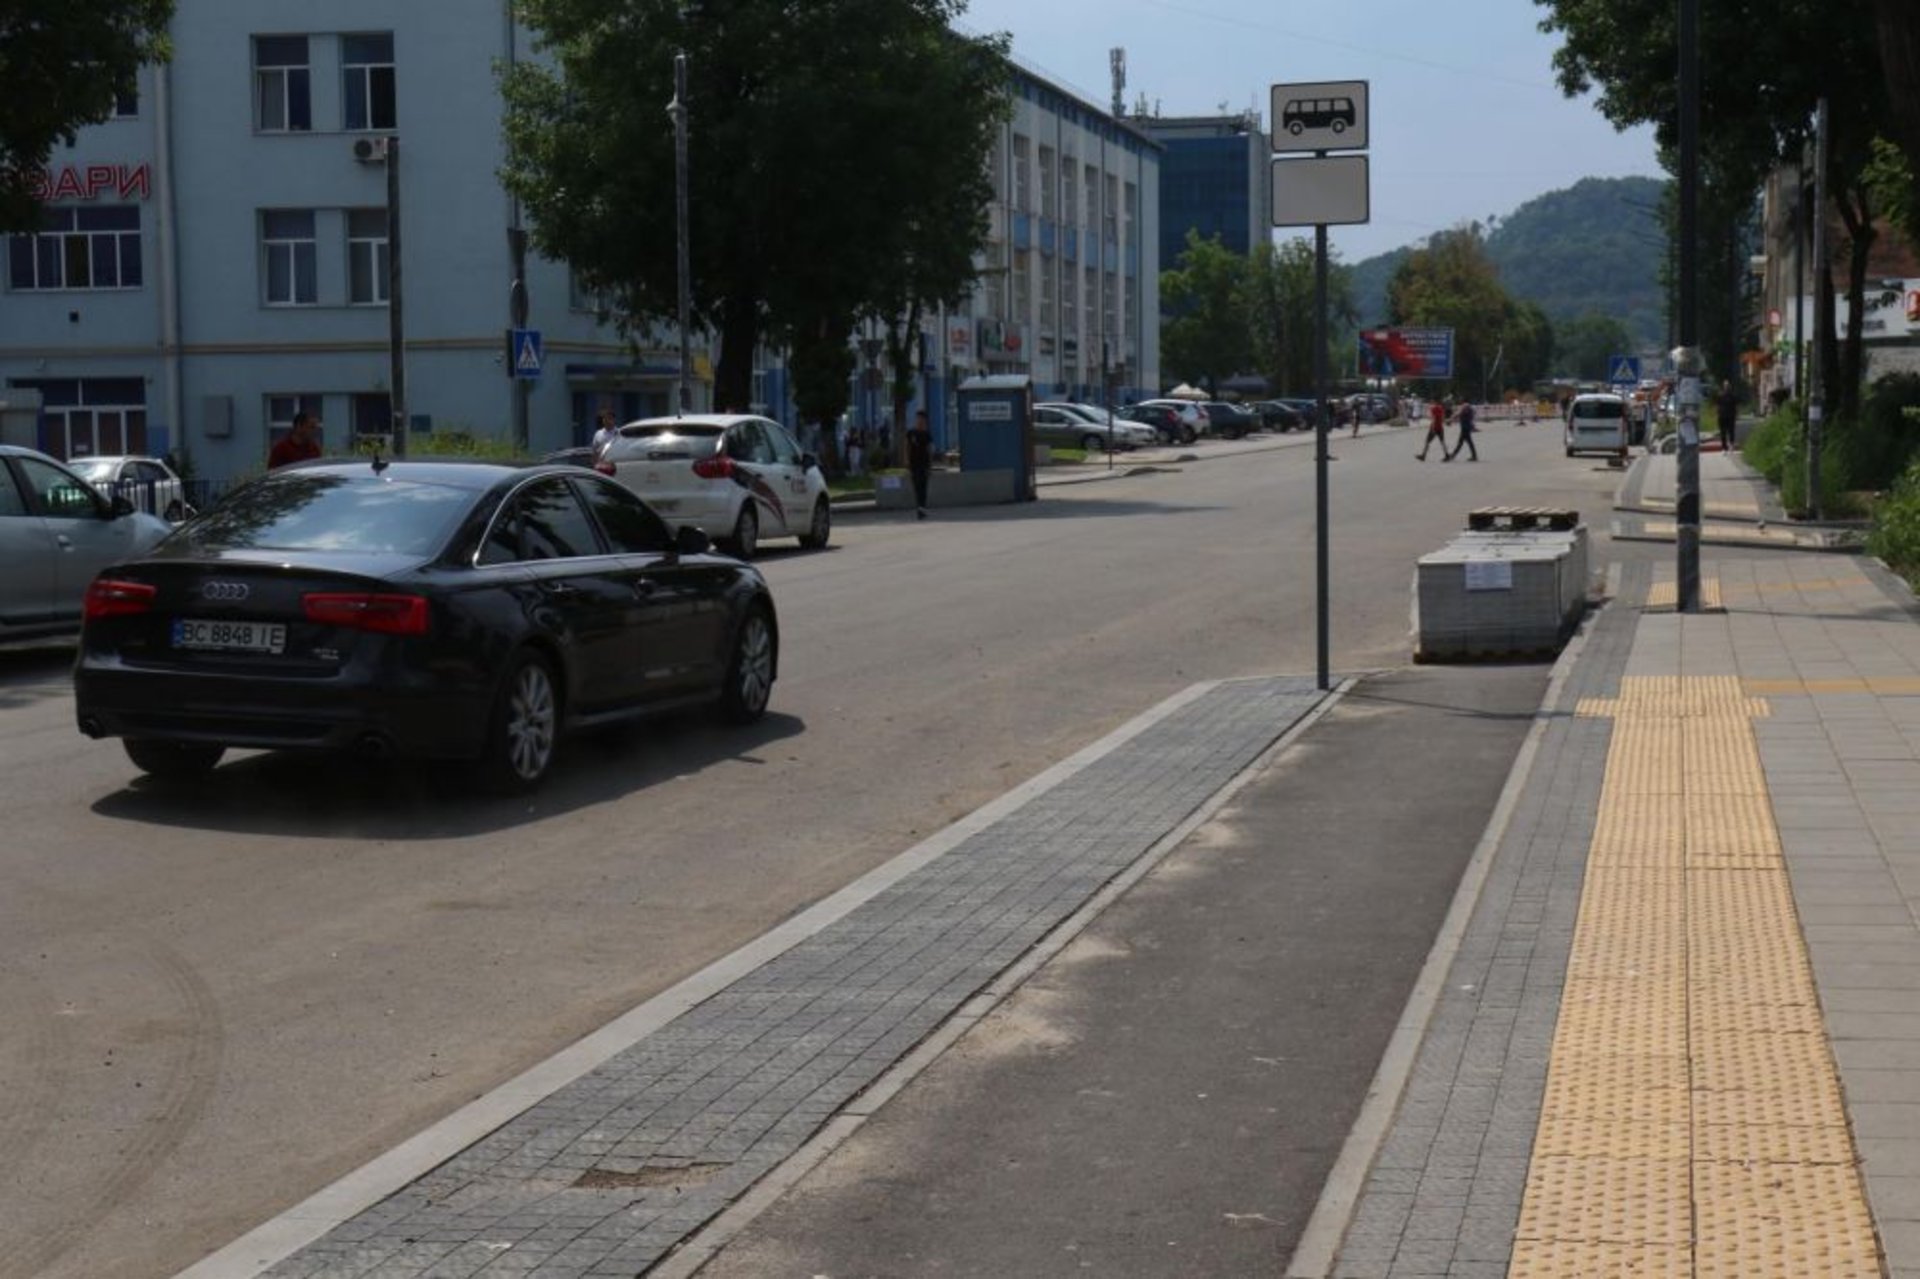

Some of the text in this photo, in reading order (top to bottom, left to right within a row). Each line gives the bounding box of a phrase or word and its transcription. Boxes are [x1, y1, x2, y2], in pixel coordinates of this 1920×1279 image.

[183, 623, 285, 647] BC 8848 IE
